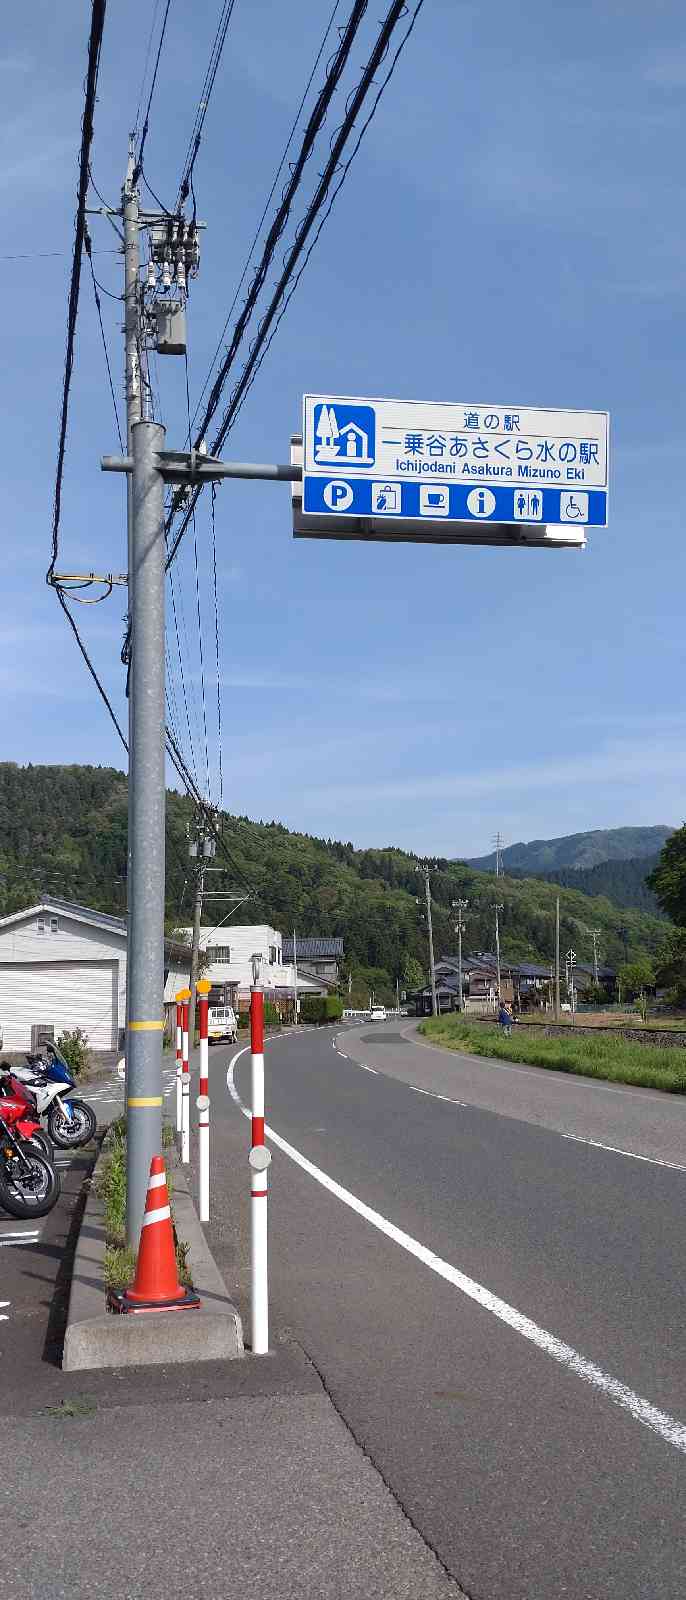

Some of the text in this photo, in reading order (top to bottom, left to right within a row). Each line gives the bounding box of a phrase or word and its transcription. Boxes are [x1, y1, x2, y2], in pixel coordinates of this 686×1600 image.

[463, 411, 521, 432] 道の駅
[381, 433, 600, 465] 一乗谷あさくら水の駅
[396, 459, 585, 480] Ichijodani Asakura Mizuno Eki
[331, 485, 348, 506] P
